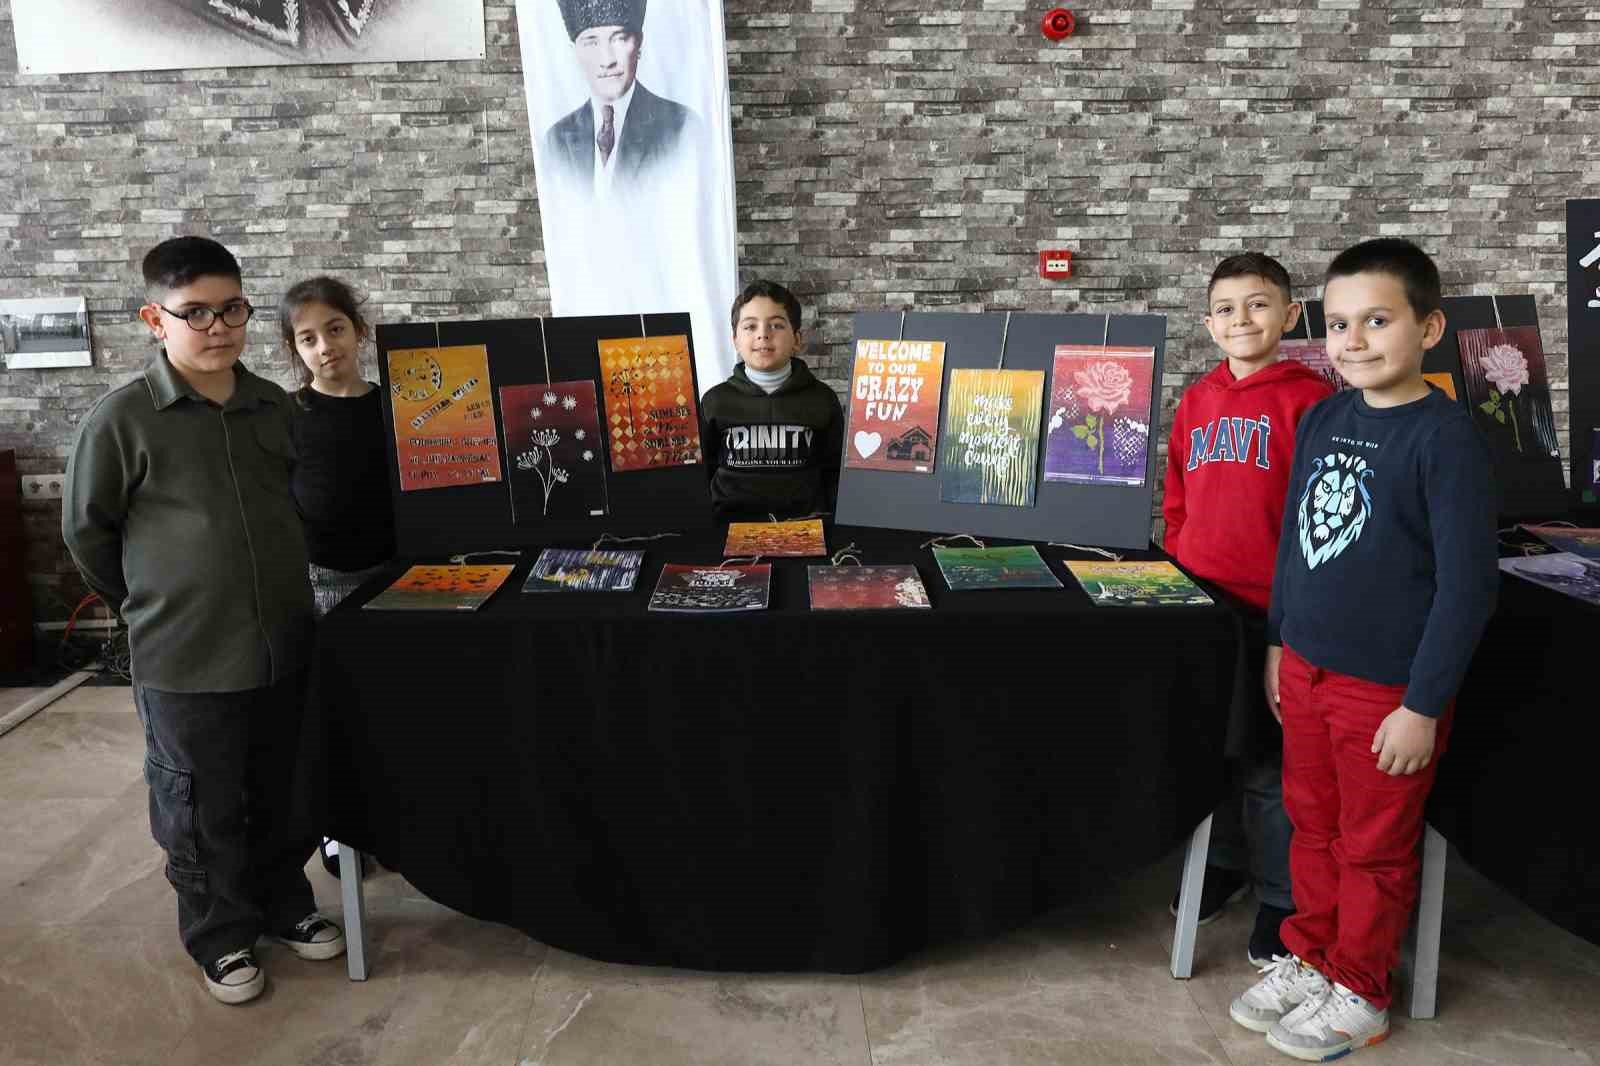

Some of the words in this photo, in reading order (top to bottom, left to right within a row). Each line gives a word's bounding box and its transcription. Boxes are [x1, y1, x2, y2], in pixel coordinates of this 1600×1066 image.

[857, 341, 932, 361] WELCOME
[868, 362, 884, 373] TO
[888, 363, 917, 375] OUR
[856, 375, 923, 402] CRAZY
[866, 402, 907, 420] FUN
[1187, 415, 1270, 471] MAVİ
